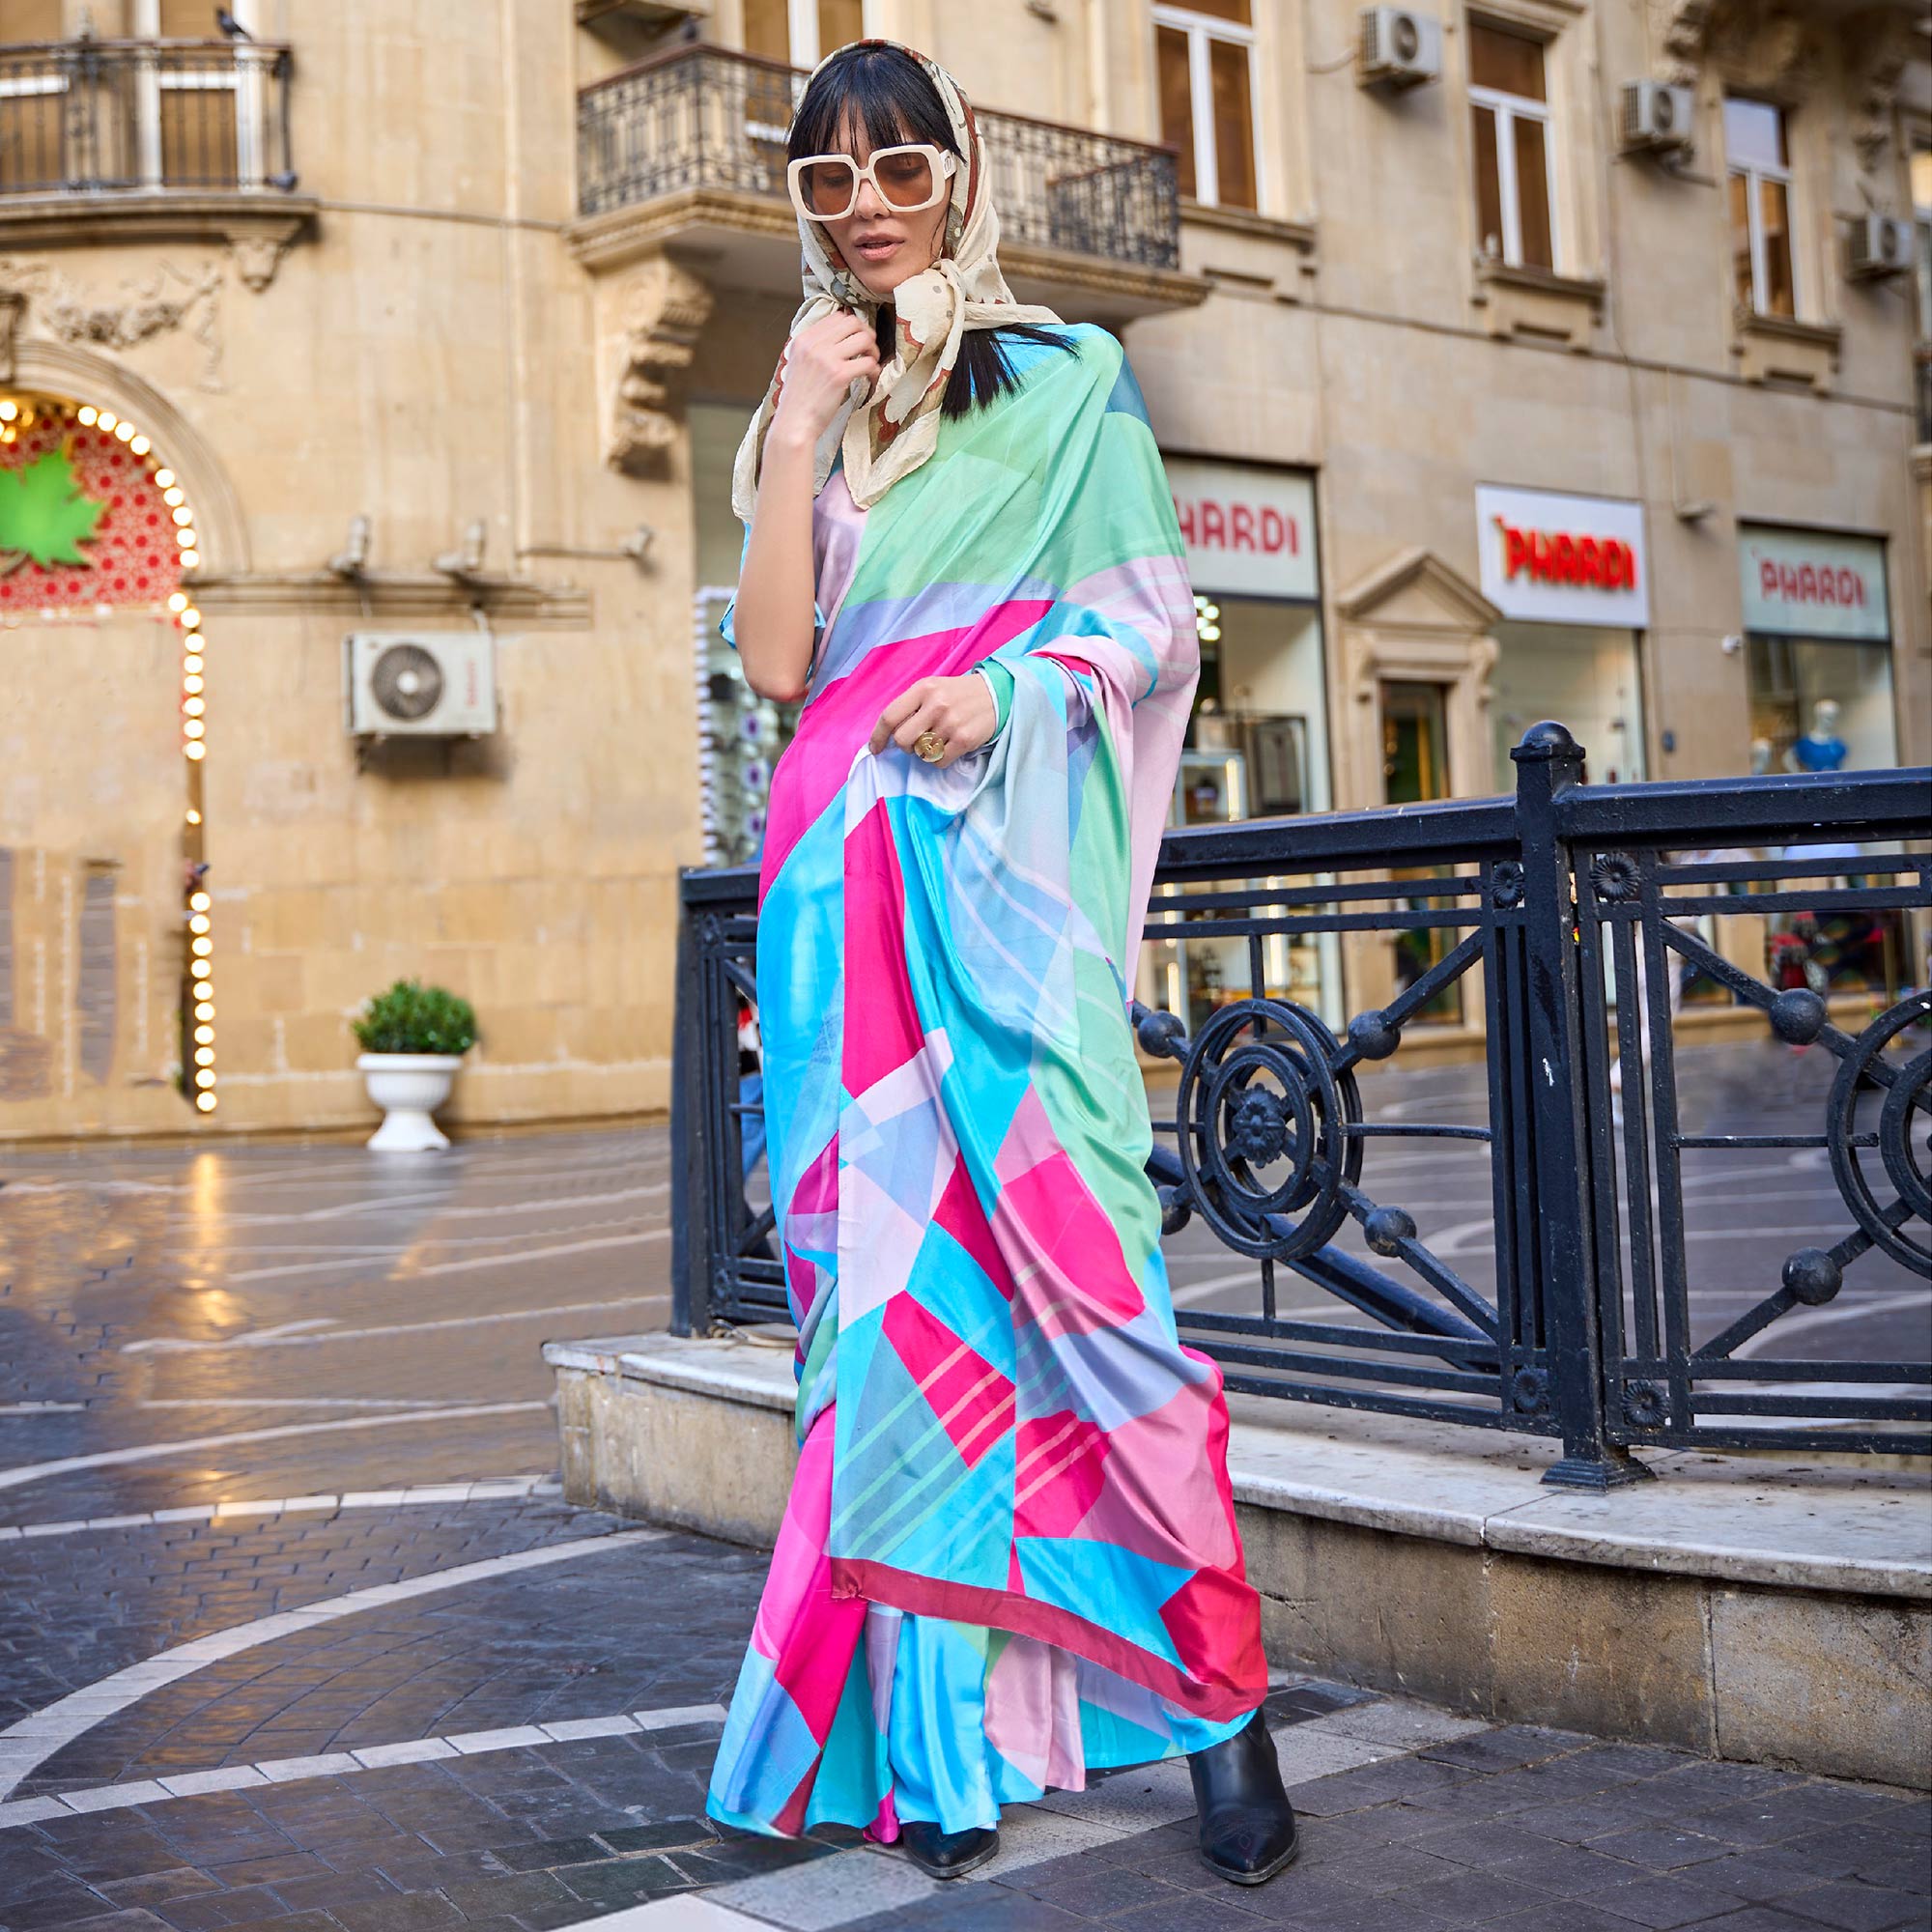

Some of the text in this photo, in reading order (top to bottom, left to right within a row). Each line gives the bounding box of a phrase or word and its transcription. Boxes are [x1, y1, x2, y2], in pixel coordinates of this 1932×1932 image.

[1173, 495, 1299, 556] HARDI
[1503, 526, 1636, 591] PHARDI
[1760, 557, 1865, 608] PHARDI
